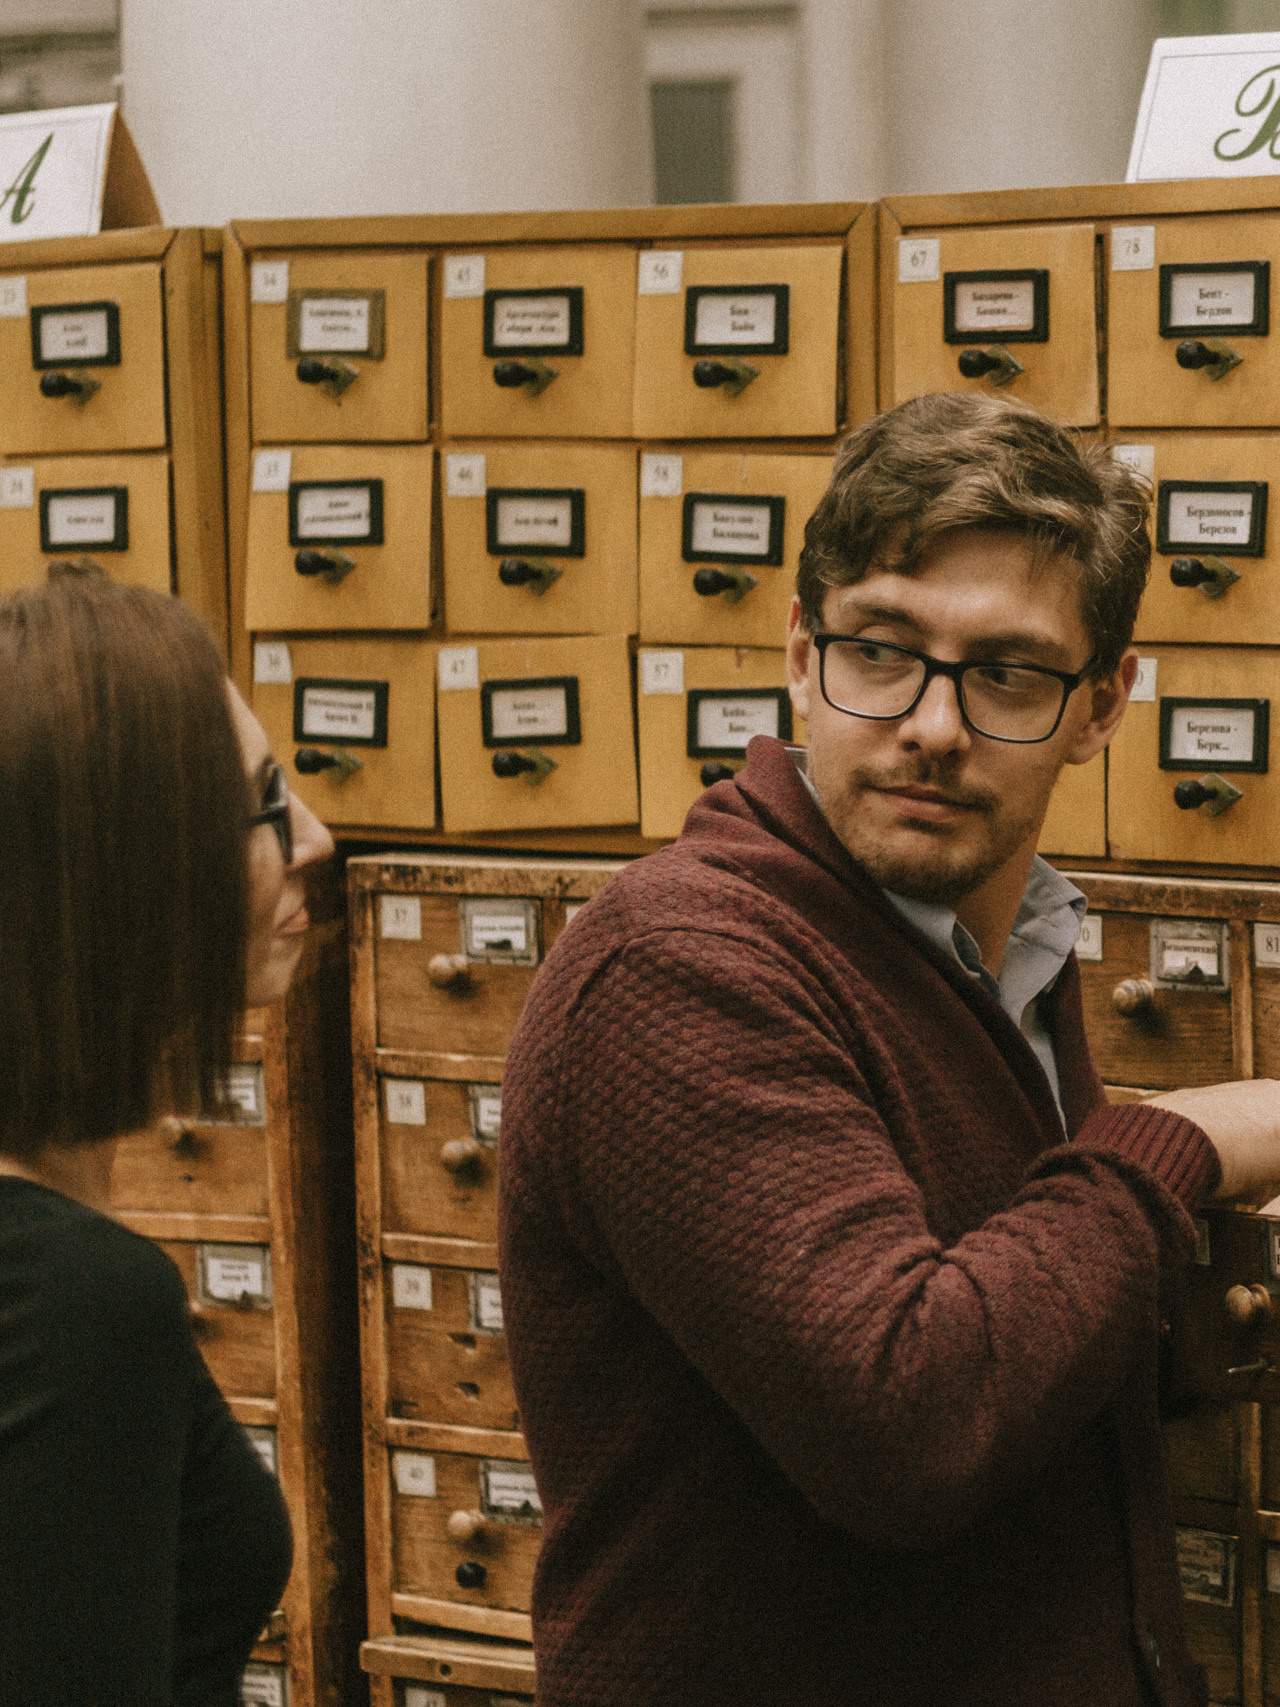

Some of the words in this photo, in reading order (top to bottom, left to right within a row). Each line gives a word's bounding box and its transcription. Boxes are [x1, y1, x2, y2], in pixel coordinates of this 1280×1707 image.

[0, 130, 56, 228] А
[911, 251, 928, 267] 67
[1266, 936, 1280, 954] 81
